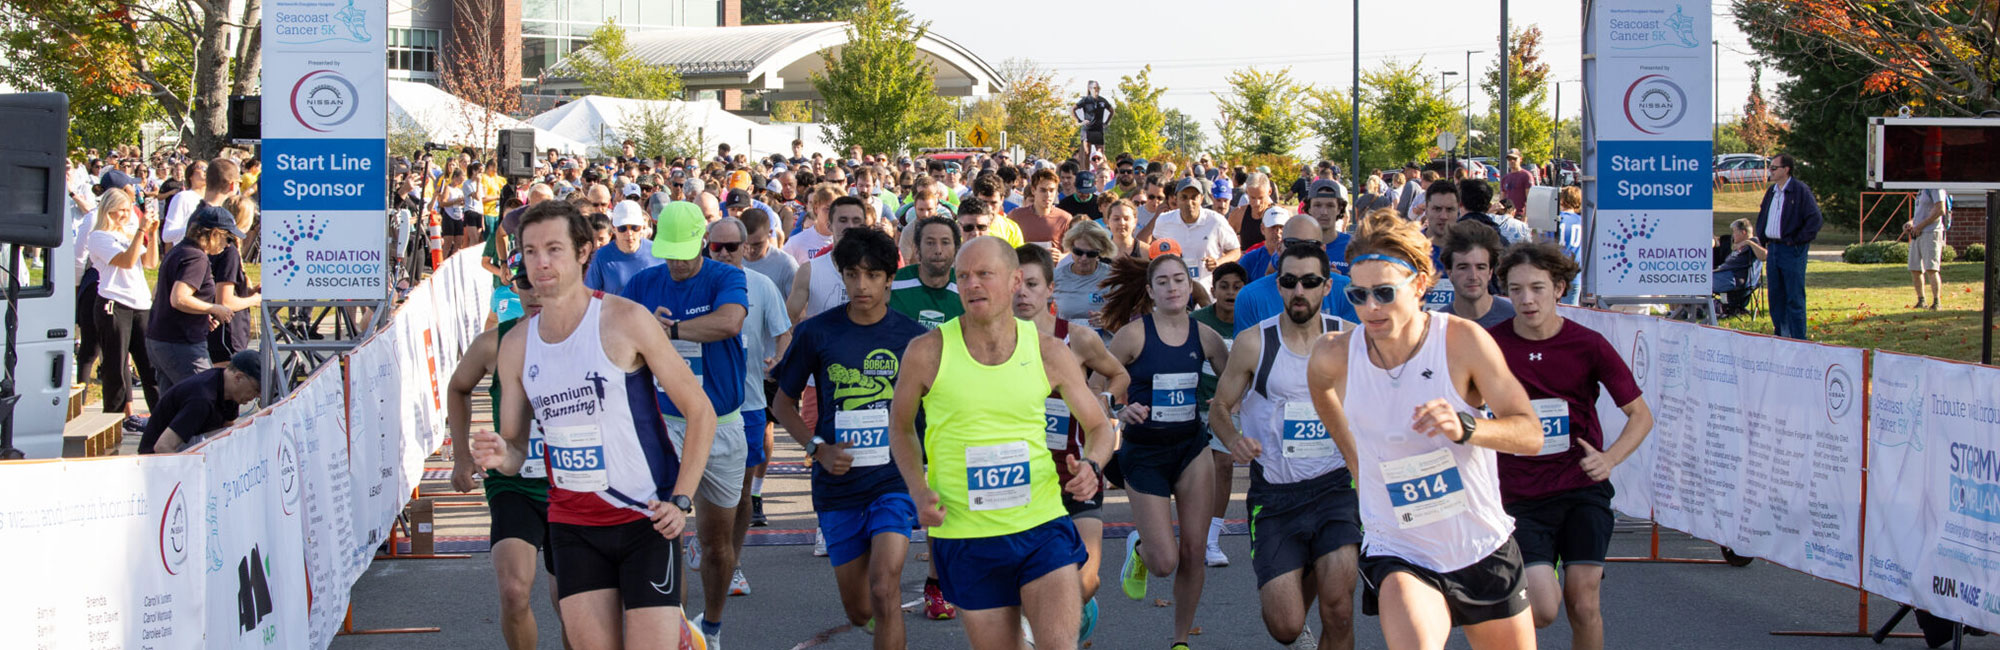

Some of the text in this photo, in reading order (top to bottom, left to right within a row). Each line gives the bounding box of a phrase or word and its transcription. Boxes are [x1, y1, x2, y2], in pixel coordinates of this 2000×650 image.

[276, 12, 329, 23] Seacoast
[1609, 19, 1660, 29] Seacoast
[276, 25, 336, 35] Cancer 5K
[1609, 31, 1666, 41] Cancer 5K
[276, 153, 372, 171] Start Line
[1611, 155, 1699, 171] Start Line
[283, 179, 365, 200] Sponsor
[1617, 180, 1693, 200] Sponsor
[306, 250, 380, 262] RADIATION
[1638, 248, 1707, 259] RADIATION
[306, 263, 380, 275] ONCOLOGY
[1638, 261, 1707, 271] ONCOLOGY
[306, 277, 381, 287] ASSOCIATES
[1639, 274, 1707, 284] ASSOCIATES
[864, 359, 894, 370] BOBCAT
[1167, 391, 1185, 405] 10
[542, 399, 595, 420] Running
[1931, 394, 1967, 418] Tribute
[1046, 417, 1058, 431] 2
[1294, 422, 1326, 438] 239
[1542, 418, 1561, 435] 51
[840, 429, 884, 446] 1037
[553, 449, 599, 468] 1655
[974, 465, 1025, 488] 1672
[1402, 474, 1448, 501] 814
[1933, 576, 1959, 598] RUN.
